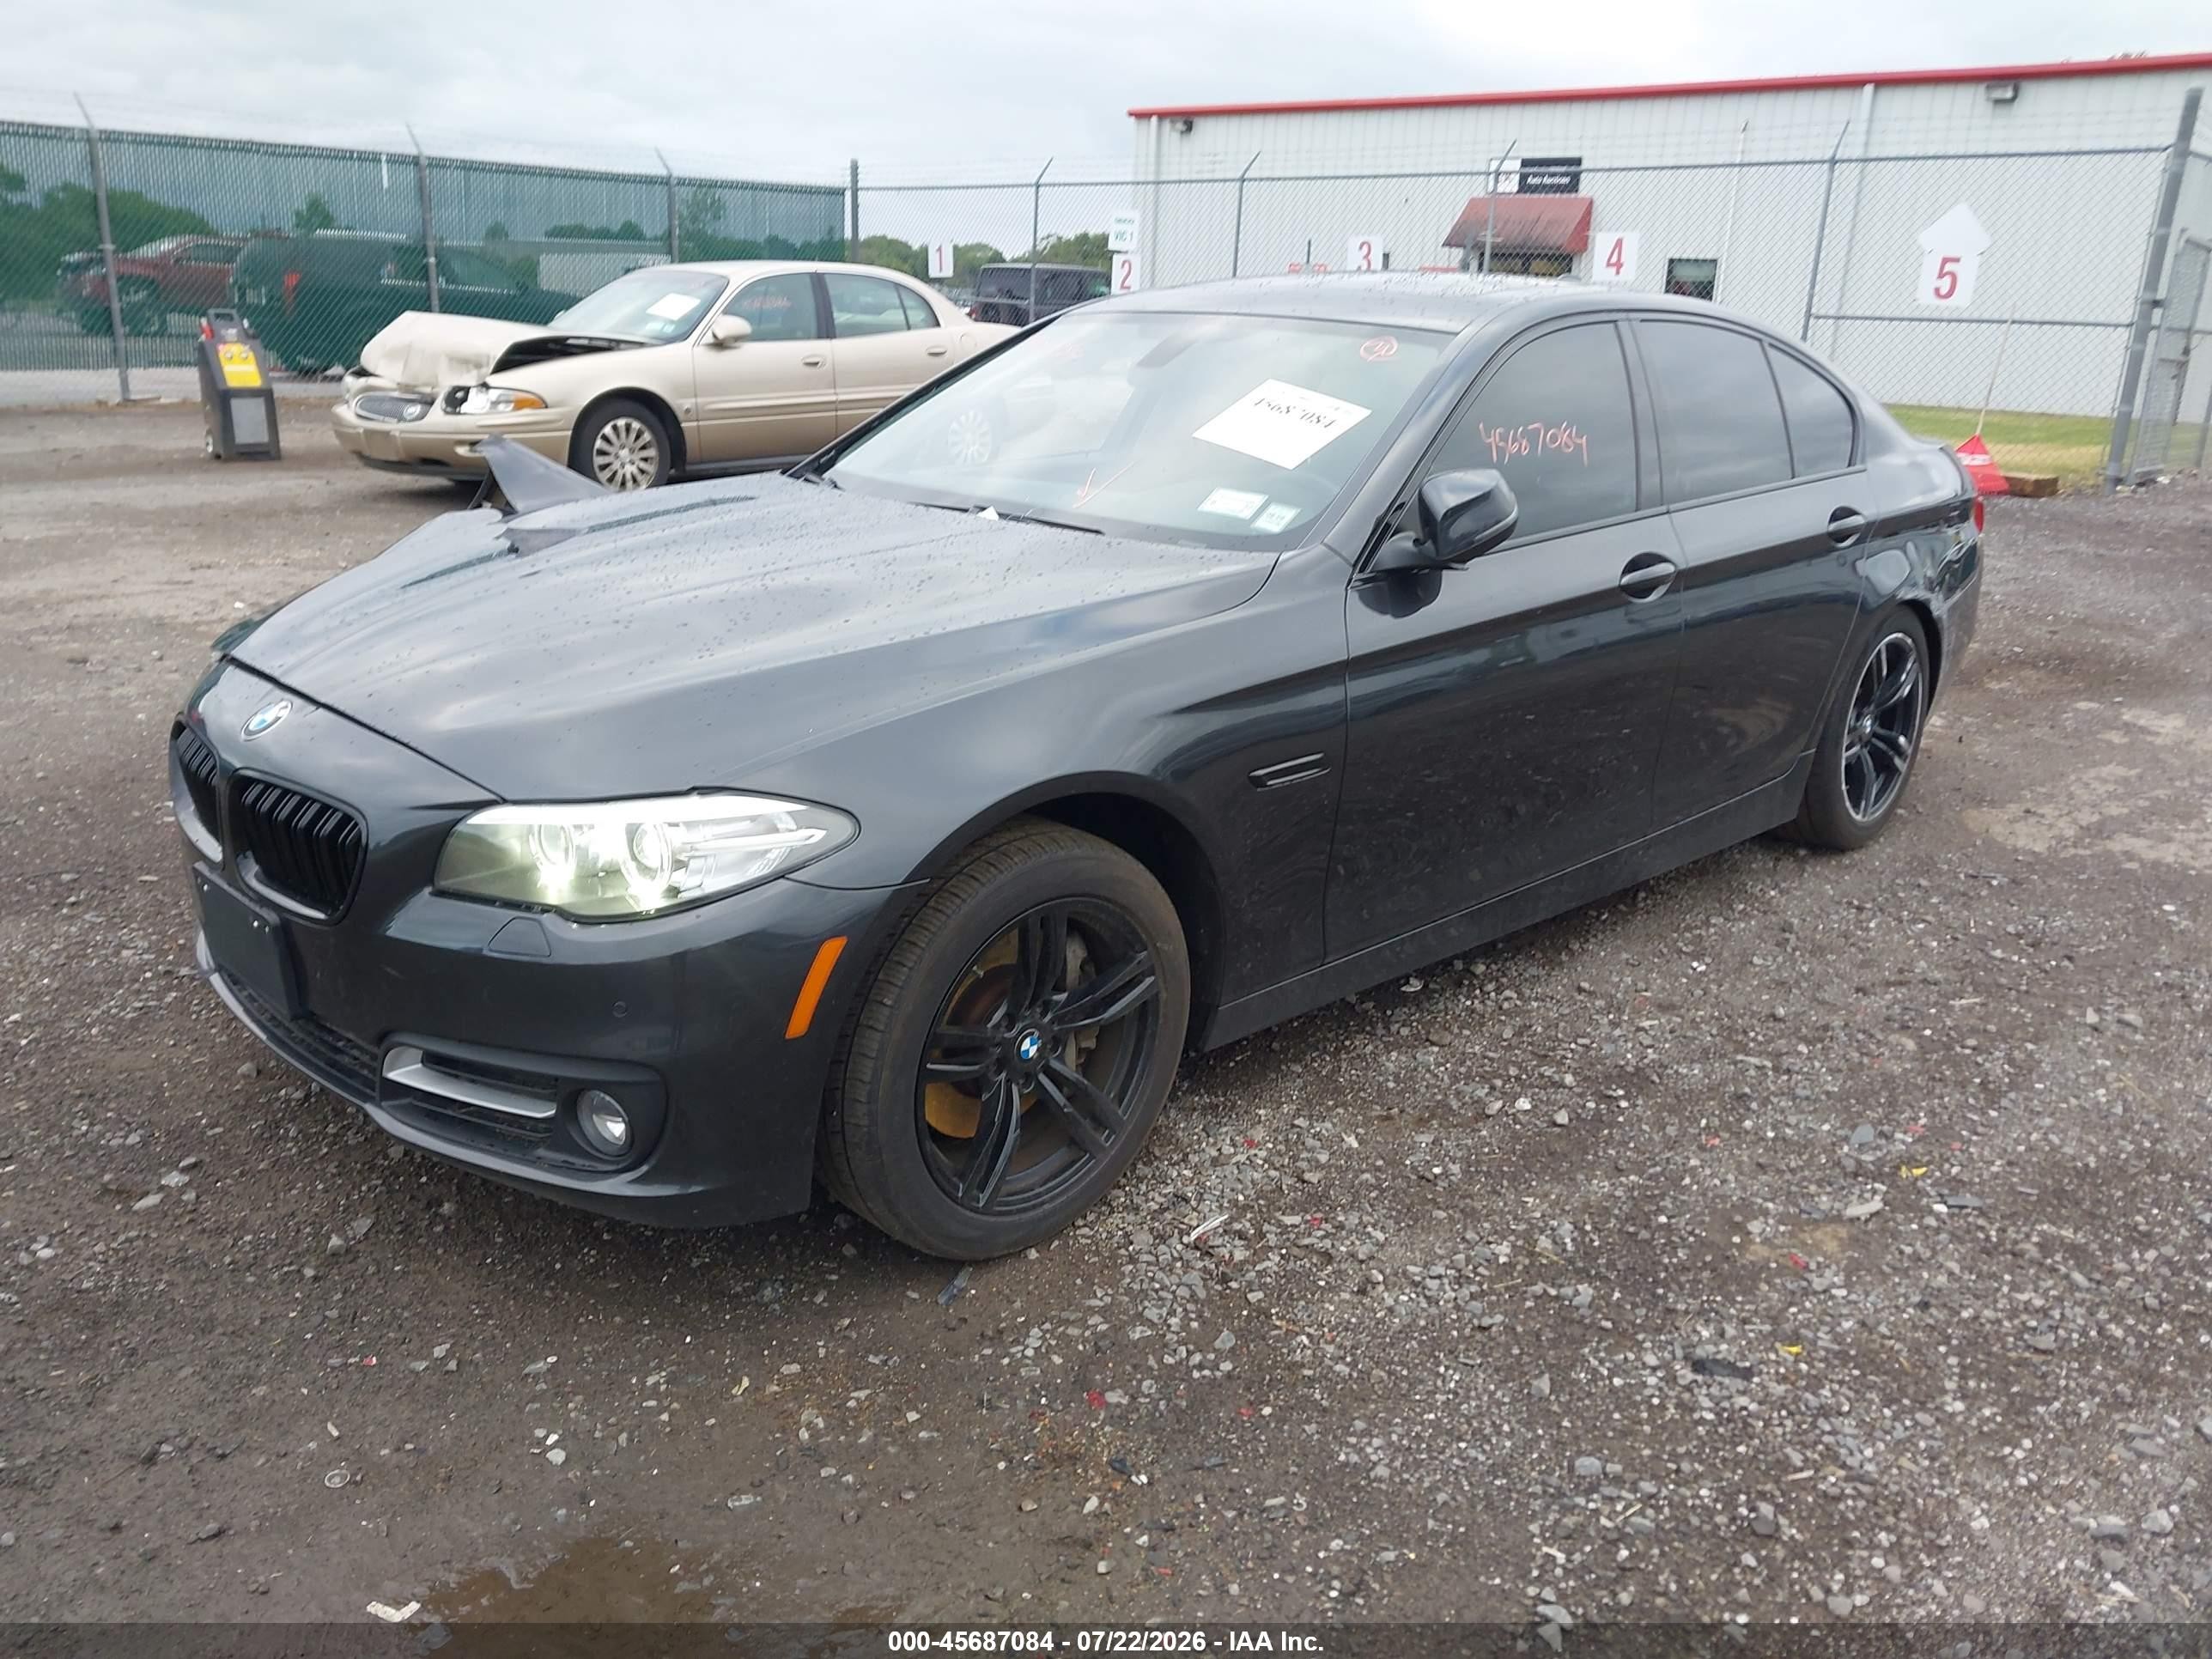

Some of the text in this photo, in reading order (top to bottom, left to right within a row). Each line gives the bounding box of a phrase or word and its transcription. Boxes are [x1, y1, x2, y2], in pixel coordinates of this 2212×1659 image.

[935, 245, 943, 273] 1
[1358, 241, 1372, 270] 3
[1606, 238, 1624, 276] 4
[1120, 259, 1133, 289] 2
[1934, 256, 1962, 300] 5
[1479, 420, 1588, 467] 45687084
